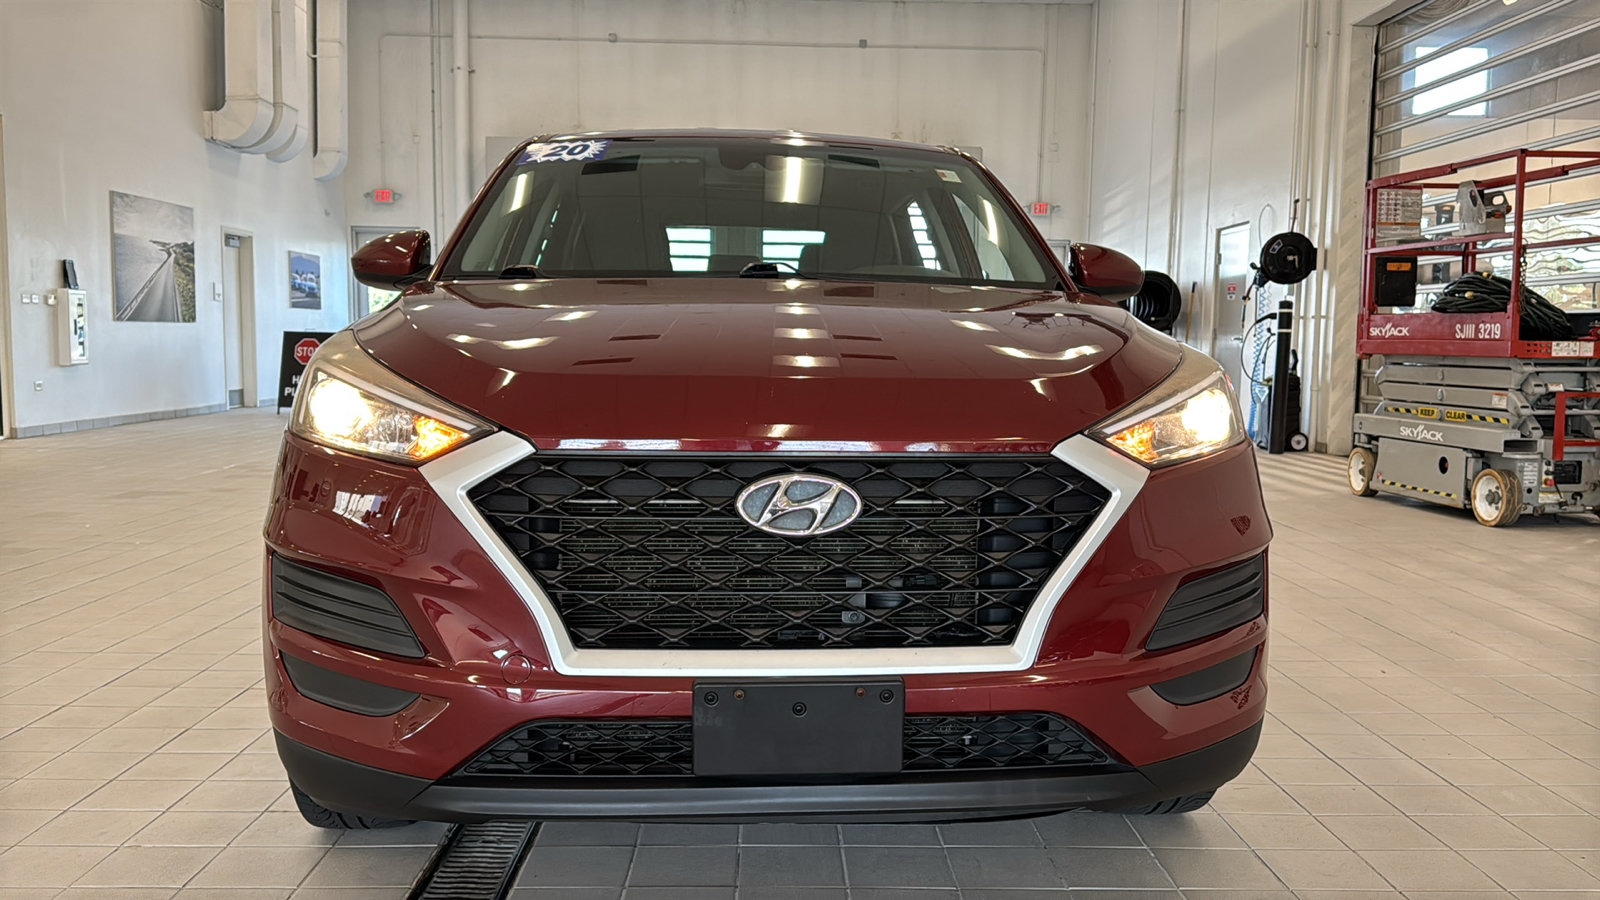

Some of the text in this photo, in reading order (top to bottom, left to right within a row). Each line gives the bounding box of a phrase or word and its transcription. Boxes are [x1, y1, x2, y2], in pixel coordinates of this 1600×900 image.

[541, 143, 591, 157] 20
[1033, 202, 1049, 215] EXIT
[1369, 322, 1410, 338] SKYJACK
[1455, 323, 1501, 339] SJIII 3219
[1420, 408, 1466, 420] KEEP CLEAR
[1399, 424, 1444, 442] SKYJACK
